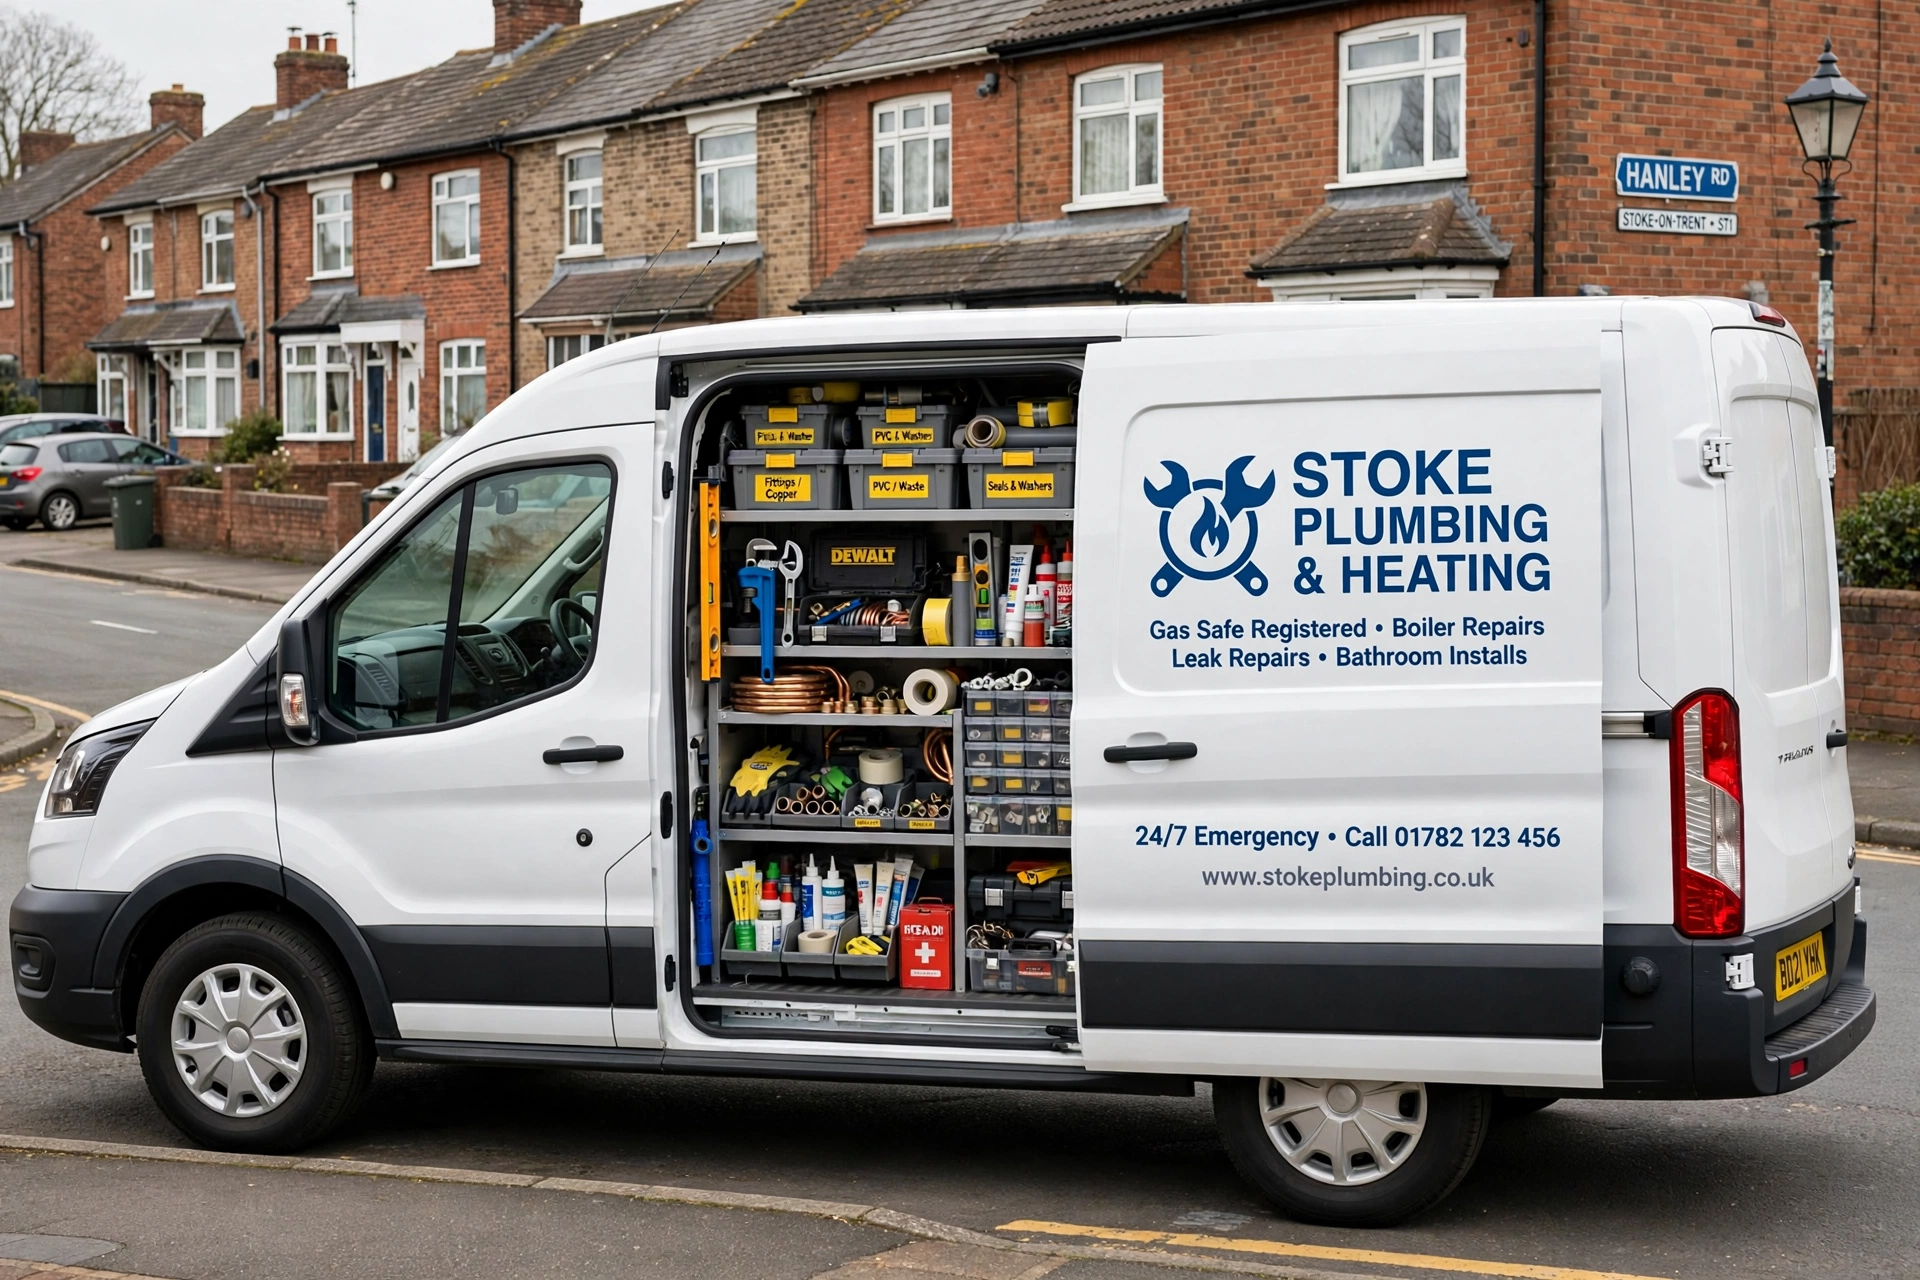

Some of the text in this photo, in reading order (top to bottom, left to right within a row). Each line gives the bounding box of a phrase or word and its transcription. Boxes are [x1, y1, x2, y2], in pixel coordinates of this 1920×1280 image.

[1626, 161, 1730, 192] HANLEY RD
[1623, 211, 1706, 230] STOKE-ON-TRENT
[875, 430, 892, 441] PVC
[873, 481, 891, 491] PVC
[898, 481, 925, 491] Waste
[1293, 449, 1492, 498] STOKE
[1294, 504, 1548, 546] PLUMBING
[831, 548, 896, 563] DEWALT
[1293, 553, 1551, 595] & HEATING
[1150, 616, 1545, 643] Gas Safe Registered Boiler Repairs
[1172, 644, 1528, 672] Leak Repairs Bathroom Installs
[1135, 824, 1561, 851] 24/7 Emergency Call 01782 123 456
[1202, 866, 1495, 891] www.stokeplumbing.co.uk
[1779, 939, 1823, 992] BD21 YHK
